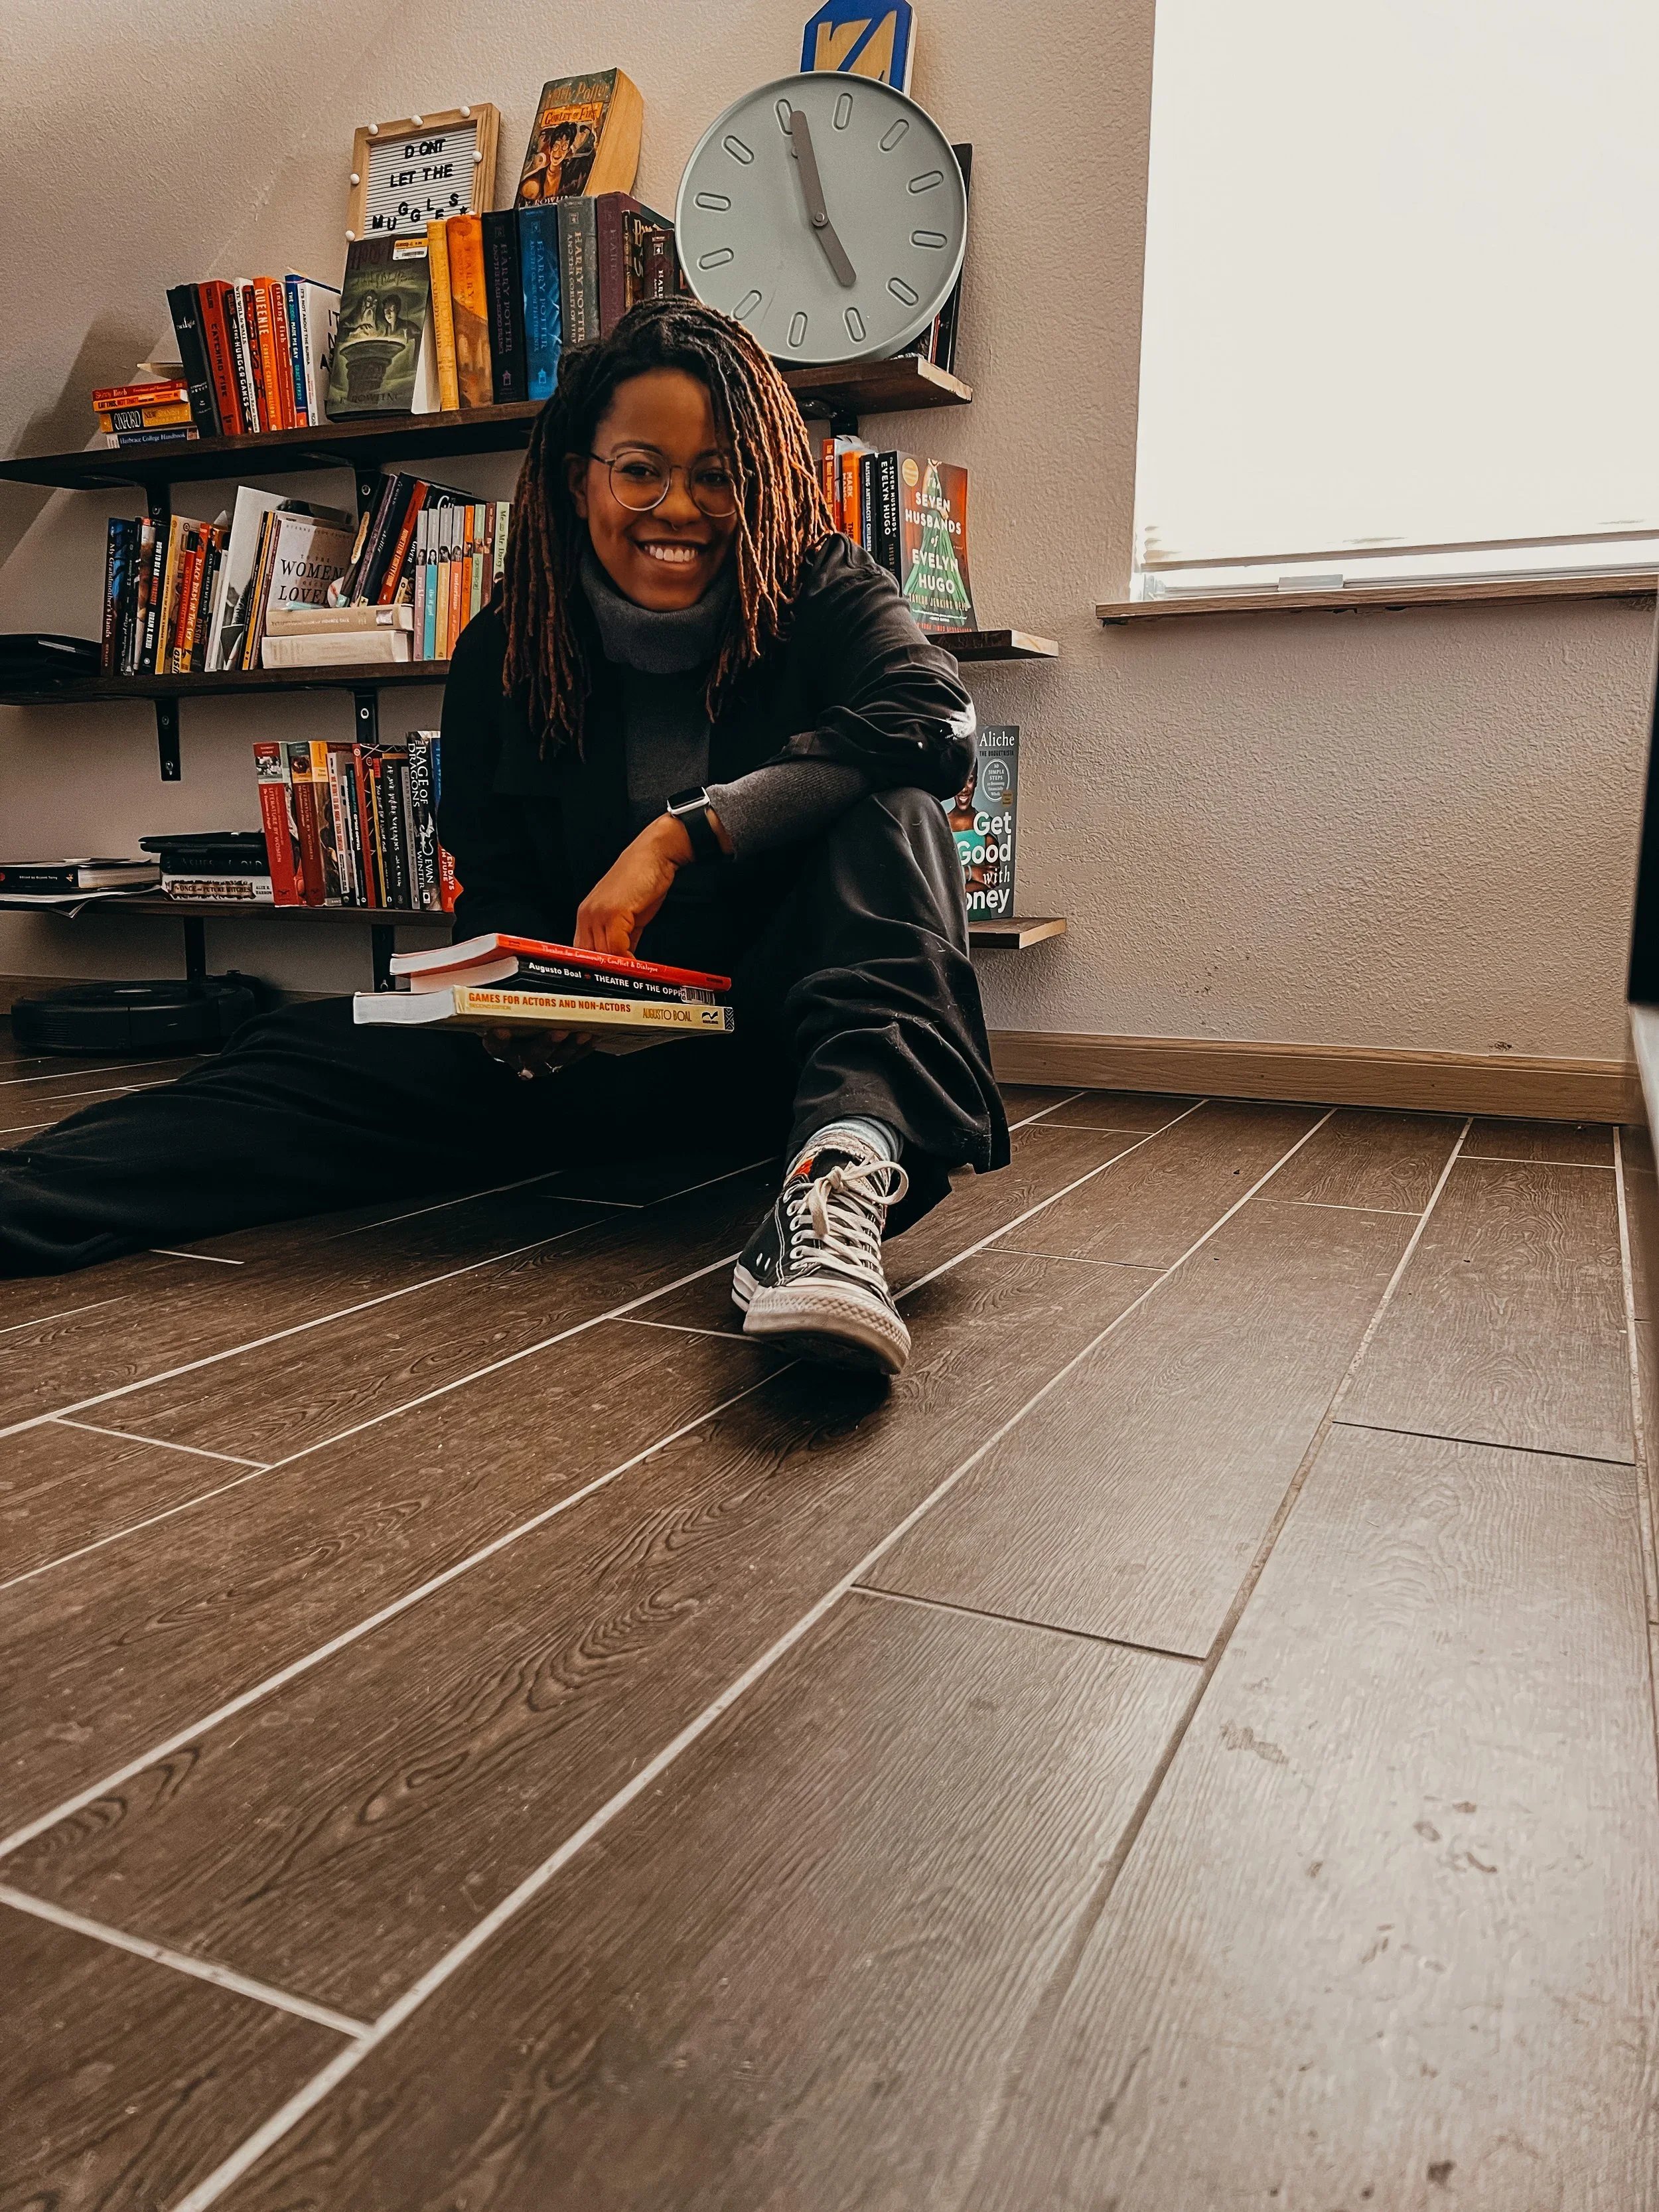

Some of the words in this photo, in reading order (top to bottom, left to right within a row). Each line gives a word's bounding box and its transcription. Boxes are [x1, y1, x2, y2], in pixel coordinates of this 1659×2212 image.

[574, 80, 611, 102] Potter
[544, 110, 572, 125] GOBLET
[390, 171, 417, 188] LET
[422, 163, 454, 182] THE
[372, 192, 460, 232] MUGGLES
[500, 243, 510, 299] HARRY
[537, 240, 545, 293] HARRY
[574, 232, 584, 286] HARRY
[254, 288, 270, 335] QUEENIE
[275, 286, 284, 323] finding
[577, 291, 585, 343] POTTER
[278, 324, 287, 344] fish
[503, 302, 513, 353] POTTER
[210, 322, 224, 372] CATCHING
[292, 337, 298, 346] ME
[234, 342, 246, 378] HUNGER
[240, 378, 250, 407] GAMES
[113, 388, 128, 397] Bitch
[113, 410, 141, 430] OXFORD
[142, 433, 161, 443] College
[161, 431, 186, 441] Handbook
[881, 461, 889, 502] EVELYN
[915, 491, 951, 513] SEVEN
[500, 510, 507, 521] Me
[882, 503, 891, 536] HUGO
[904, 508, 962, 536] HUSBANDS
[108, 543, 115, 556] My
[930, 535, 940, 548] of
[194, 557, 202, 580] BLACK
[280, 558, 345, 581] WOMEN
[496, 547, 505, 569] Darcy
[911, 548, 959, 573] EVELYN
[106, 556, 115, 614] Grandmother's
[190, 581, 200, 603] BIRDS
[918, 572, 956, 595] HUGO
[908, 593, 929, 606] TAYLOR
[930, 596, 954, 611] JENKINS
[185, 627, 194, 641] SKY
[194, 619, 203, 644] DYSON
[172, 648, 180, 674] USED
[979, 731, 1015, 747] Aliche
[407, 743, 421, 808] DRAGONS
[415, 745, 429, 786] RAGE
[301, 785, 311, 823] LITERATURE
[419, 788, 429, 805] OF
[267, 787, 278, 826] LITERATURE
[273, 827, 279, 837] BY
[973, 811, 1012, 836] Get
[957, 835, 1012, 865] Good
[424, 859, 435, 884] EVAN
[983, 865, 1010, 885] with
[966, 888, 1011, 914] oney
[607, 956, 629, 968] Conflict
[636, 962, 658, 974] Dialogue
[528, 962, 563, 975] Augusto
[563, 968, 582, 979] Boal
[594, 974, 630, 988] THEATRE
[633, 982, 644, 990] OF
[645, 984, 660, 994] THE
[469, 992, 501, 1003] GAMES
[503, 995, 520, 1005] FOR
[522, 996, 557, 1007] ACTORS
[559, 999, 577, 1009] AND
[578, 1001, 631, 1013] NON-ACTORS
[642, 1007, 672, 1021] AUGUSTO
[673, 1010, 693, 1022] BOAL
